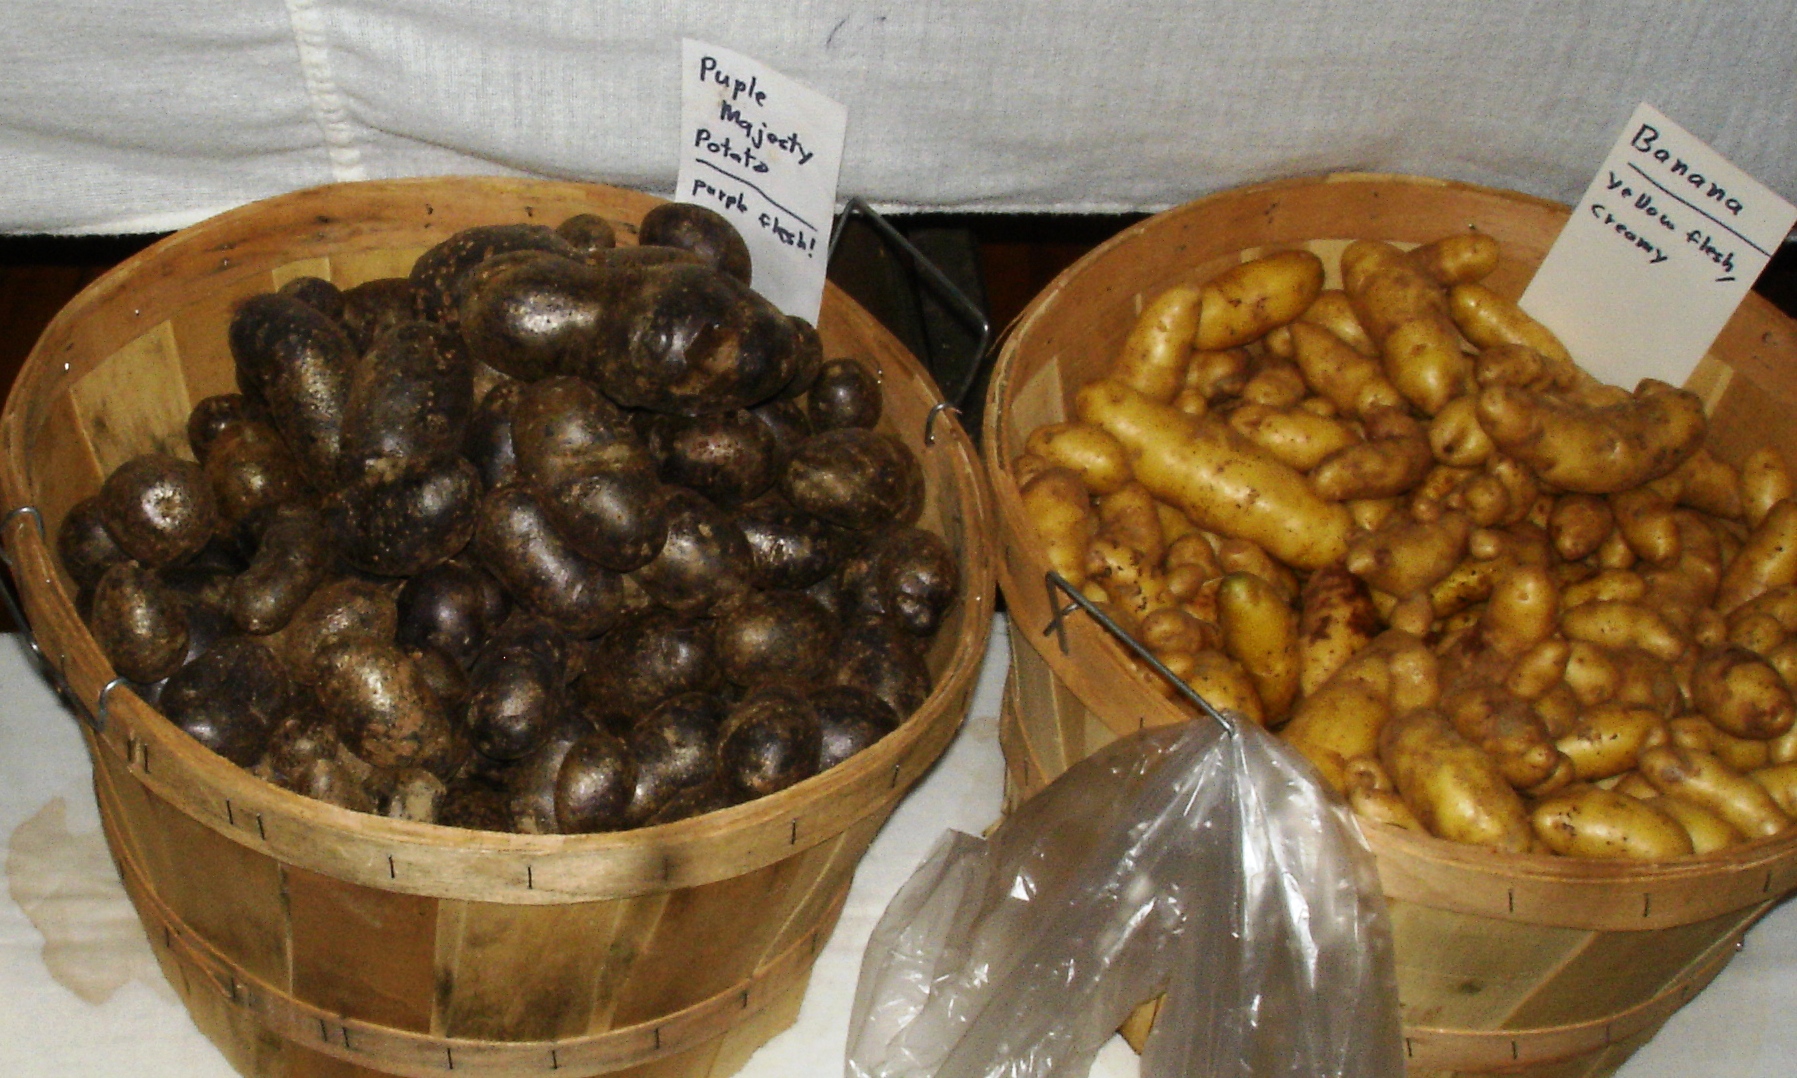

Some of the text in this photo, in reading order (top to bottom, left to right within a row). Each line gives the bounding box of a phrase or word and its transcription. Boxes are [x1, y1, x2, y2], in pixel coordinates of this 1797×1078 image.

[700, 56, 767, 107] Puple
[695, 128, 769, 173] Potato
[1631, 123, 1743, 216] Banana
